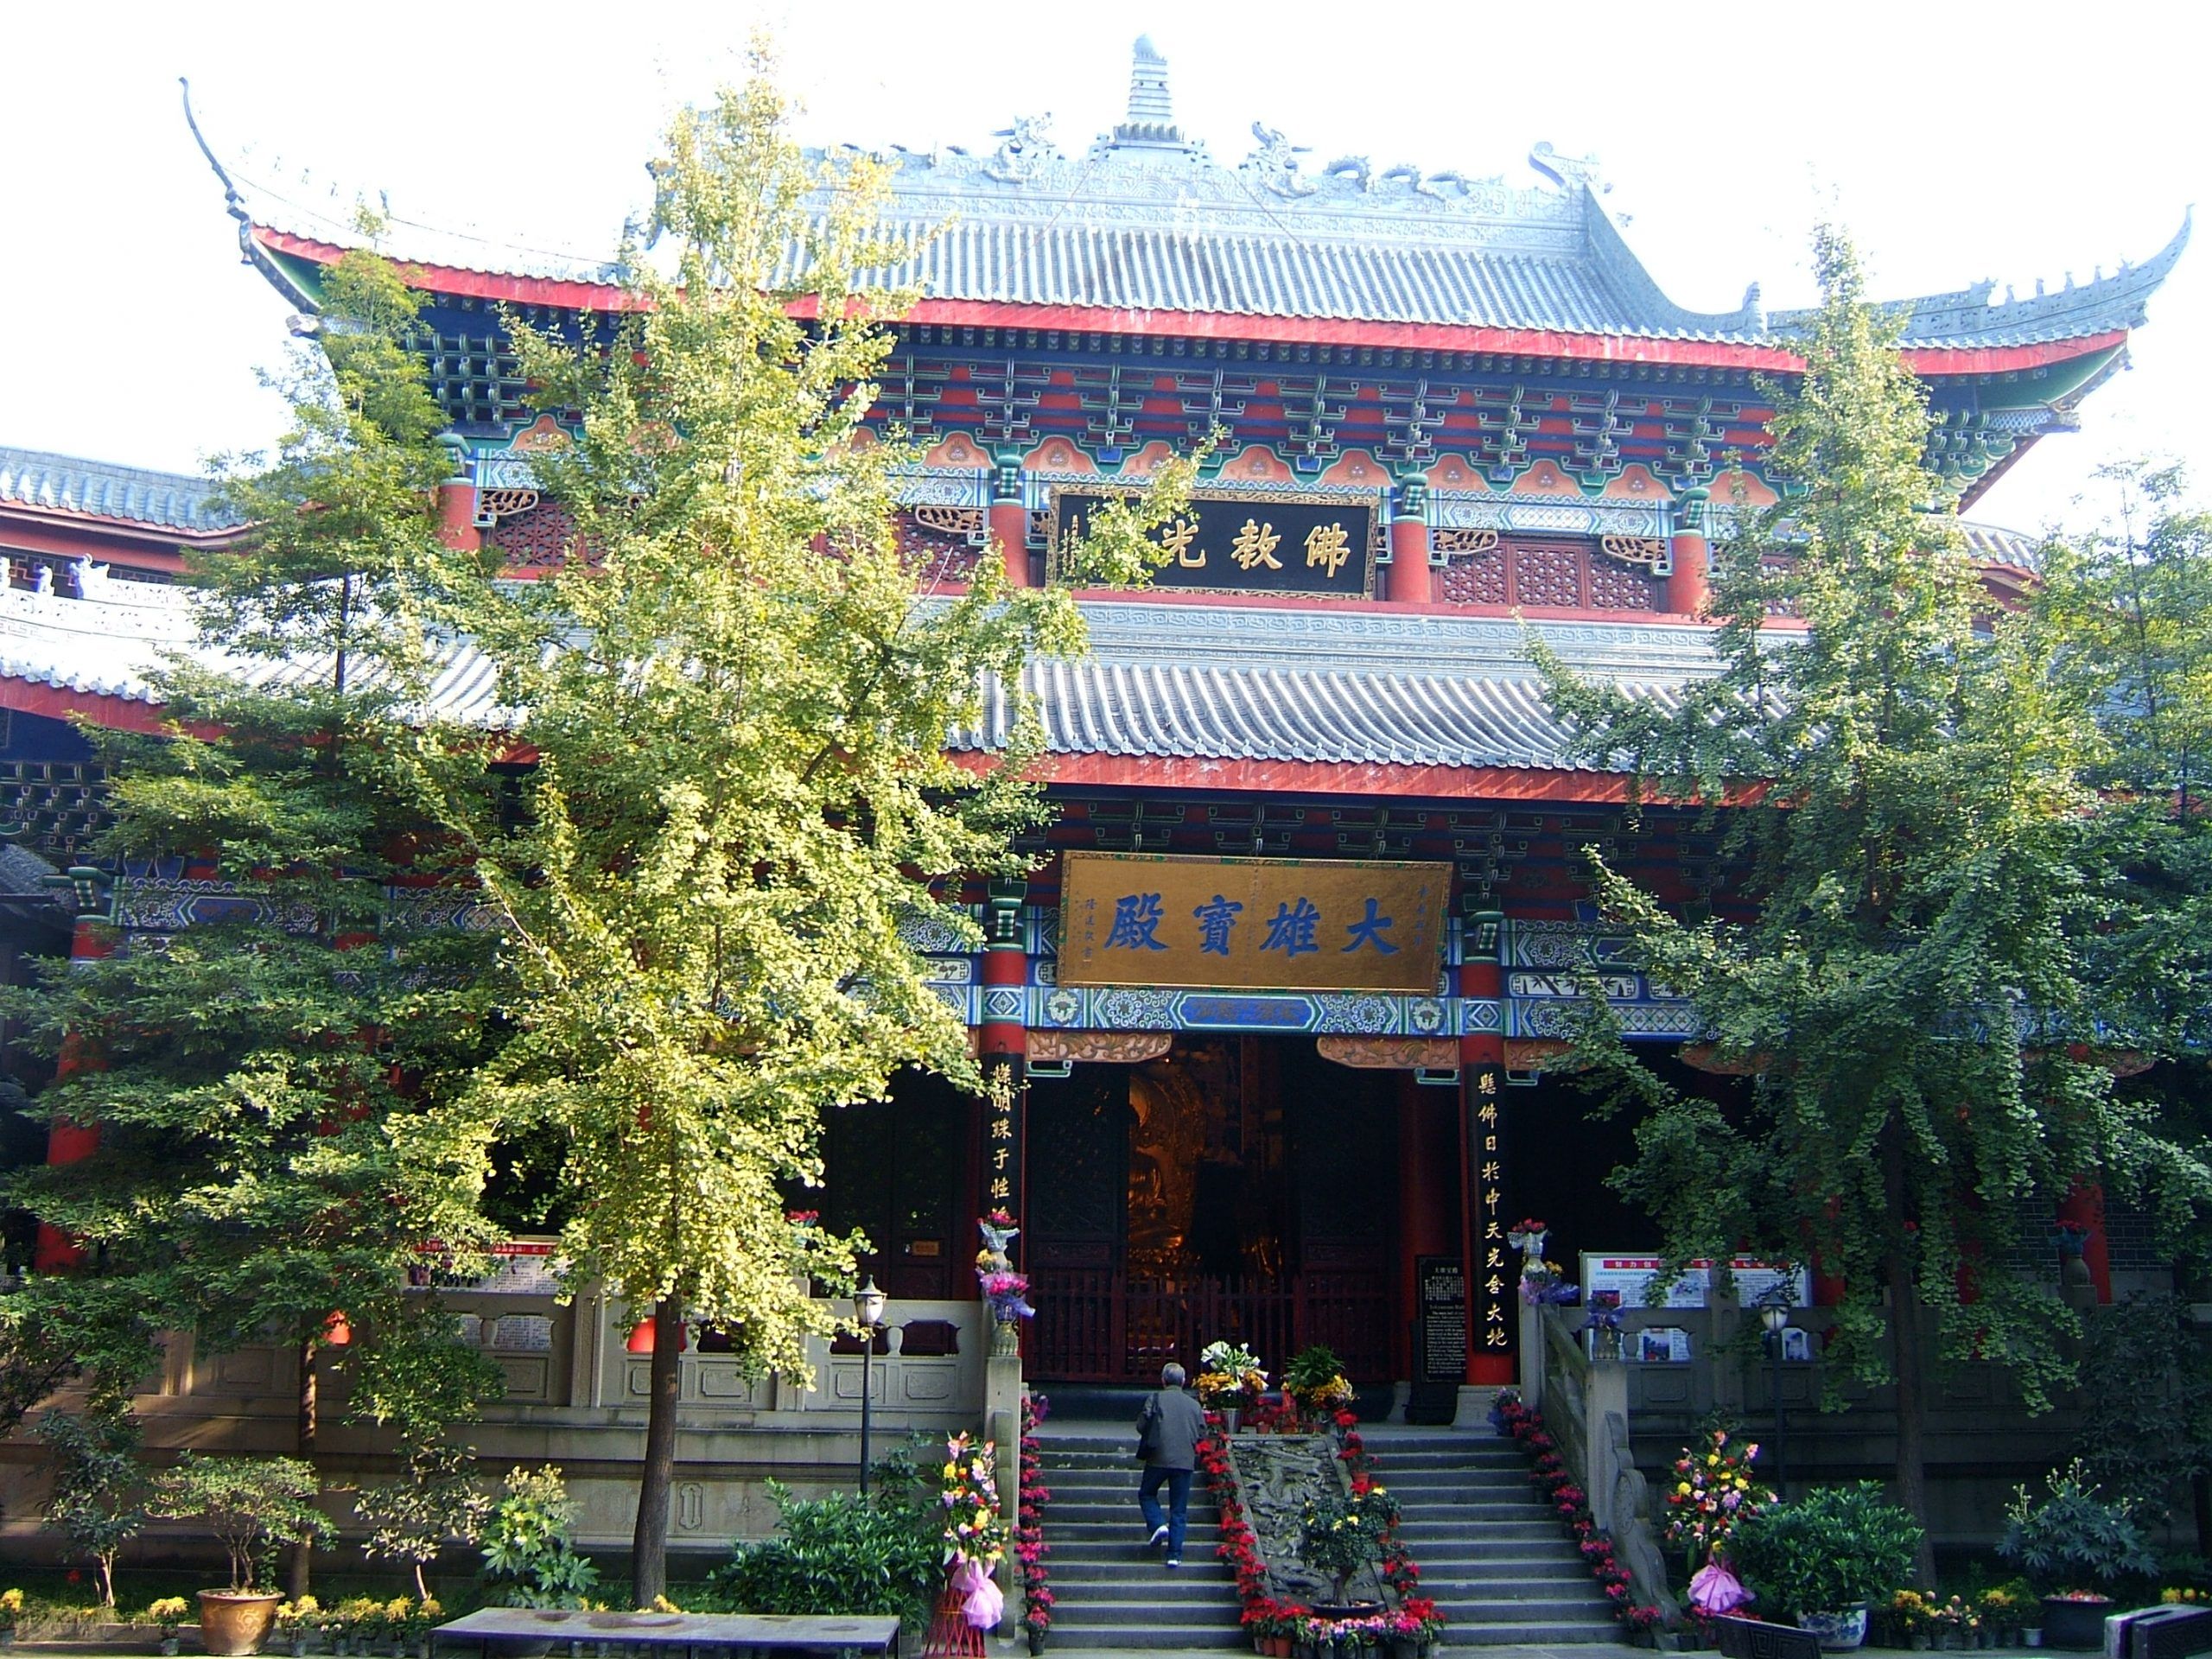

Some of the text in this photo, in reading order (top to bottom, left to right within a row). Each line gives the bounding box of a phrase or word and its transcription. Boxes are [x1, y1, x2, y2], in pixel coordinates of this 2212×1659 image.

[1161, 518, 1351, 578] 佛教光
[1104, 892, 1400, 957] 大雄寶殿
[990, 1062, 1014, 1215] 燦明珠于性
